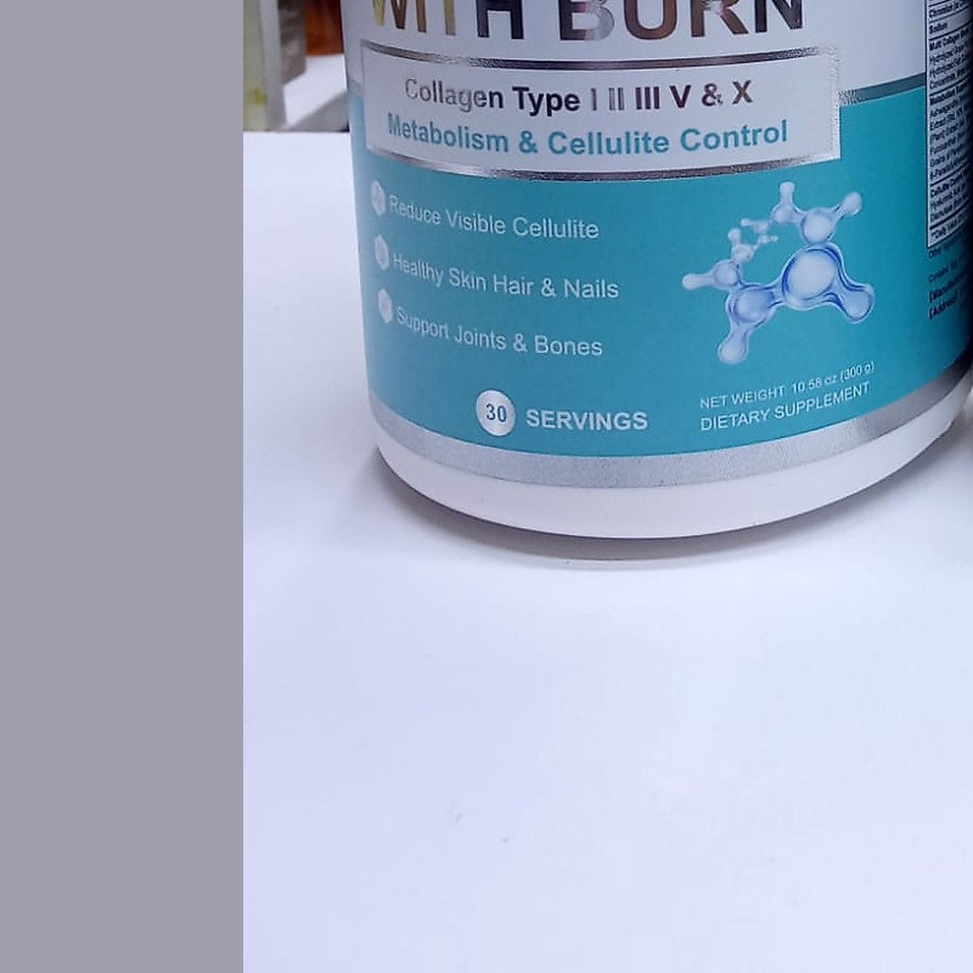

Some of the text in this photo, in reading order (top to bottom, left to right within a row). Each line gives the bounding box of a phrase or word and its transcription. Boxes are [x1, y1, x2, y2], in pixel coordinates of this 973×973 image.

[404, 78, 504, 113] Collagen
[512, 85, 580, 117] Type
[635, 86, 661, 110] III
[669, 85, 692, 109] V
[701, 82, 724, 107] &
[732, 79, 753, 105] X
[388, 112, 788, 156] Metabolism & Cellulite Control
[389, 194, 600, 240] Reduce Visible Cellulite
[392, 253, 620, 301] Healthy Skin Hair & Nails
[396, 306, 604, 356] Support Joints & Bones
[485, 402, 650, 431] 30 SERVINGS
[700, 395, 728, 409] NET
[731, 386, 786, 406] WEIGHT
[700, 381, 871, 431] DIETARY SUPPLEMENT
